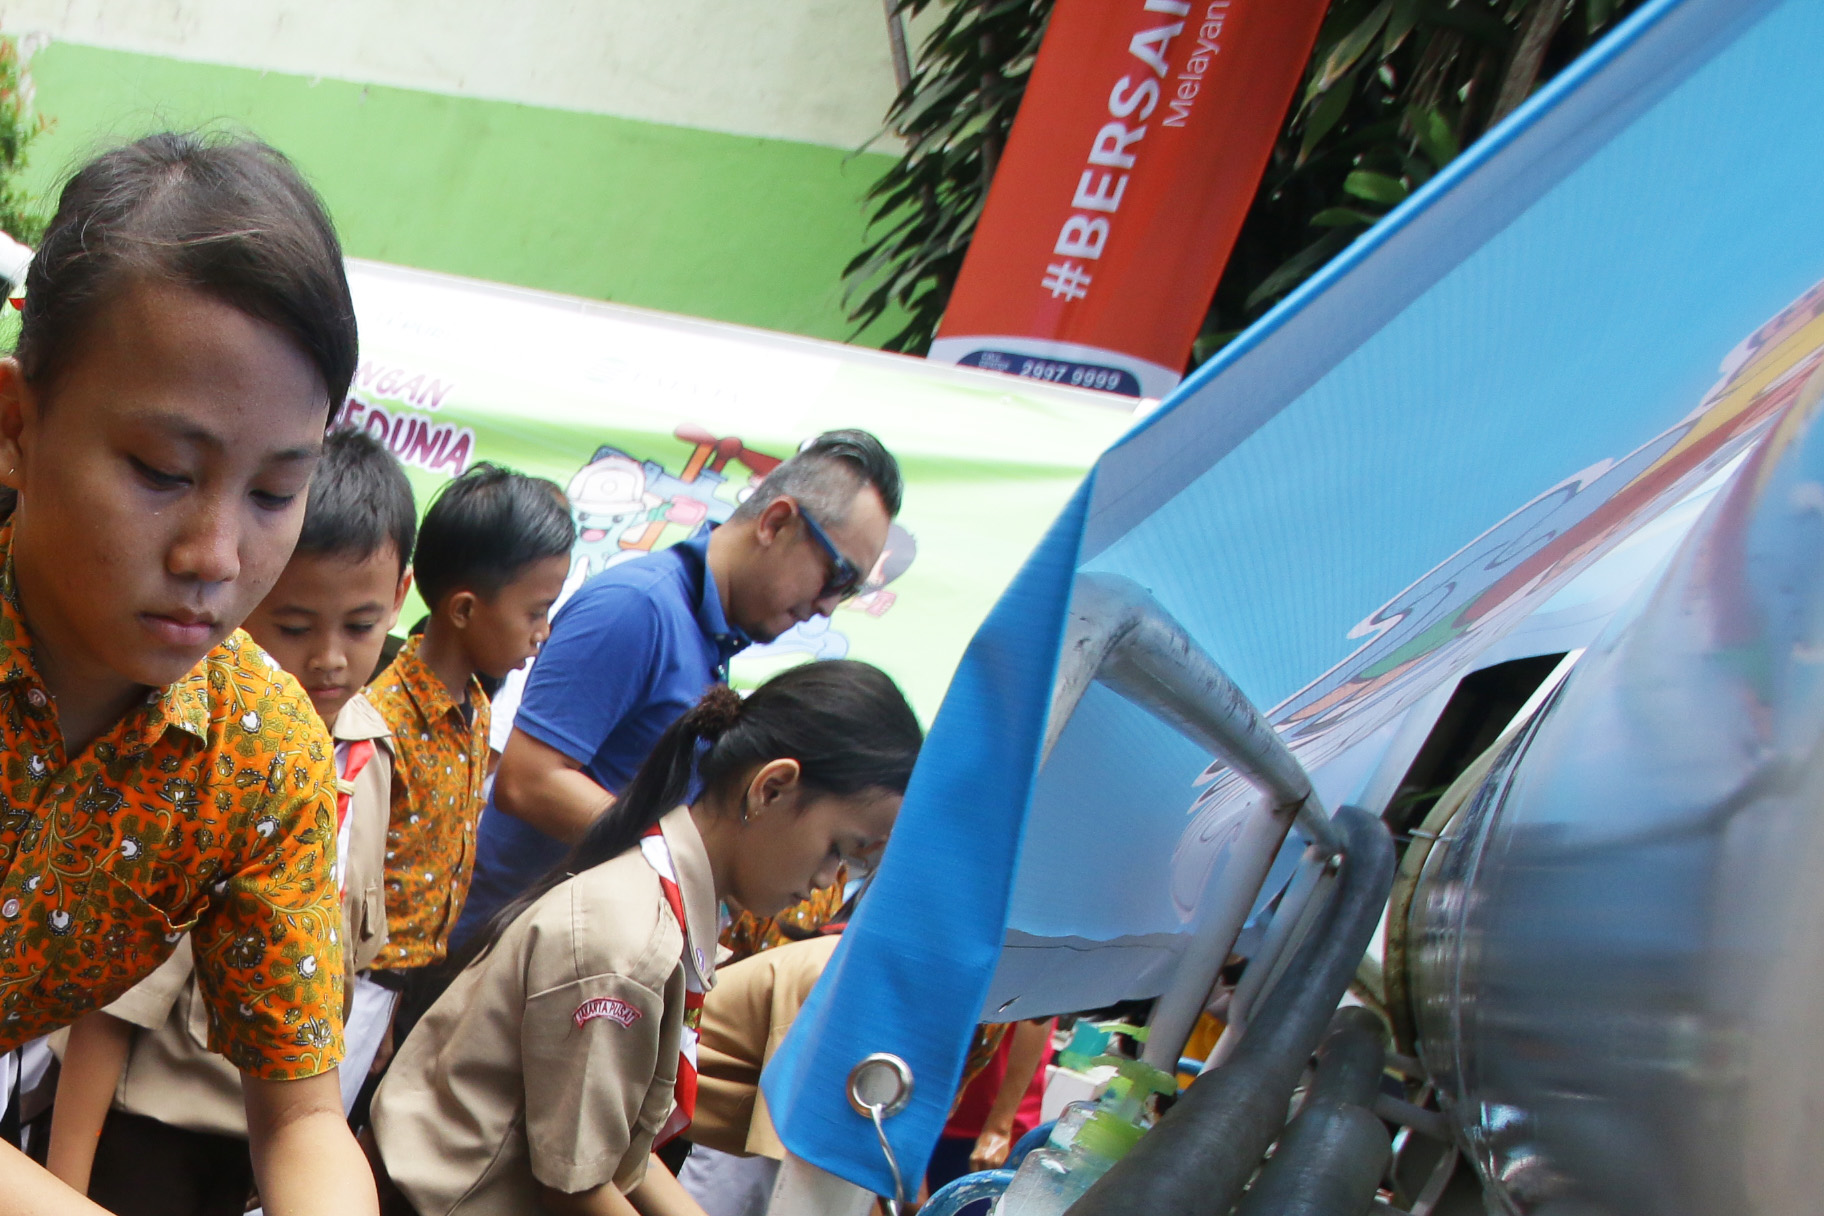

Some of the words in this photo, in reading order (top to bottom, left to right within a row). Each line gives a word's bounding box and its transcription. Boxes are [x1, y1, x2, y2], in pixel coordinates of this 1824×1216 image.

[1162, 0, 1230, 128] Melayan
[1021, 359, 1068, 382] 2997
[1071, 366, 1121, 391] 9999
[331, 399, 471, 475] EDUNIA
